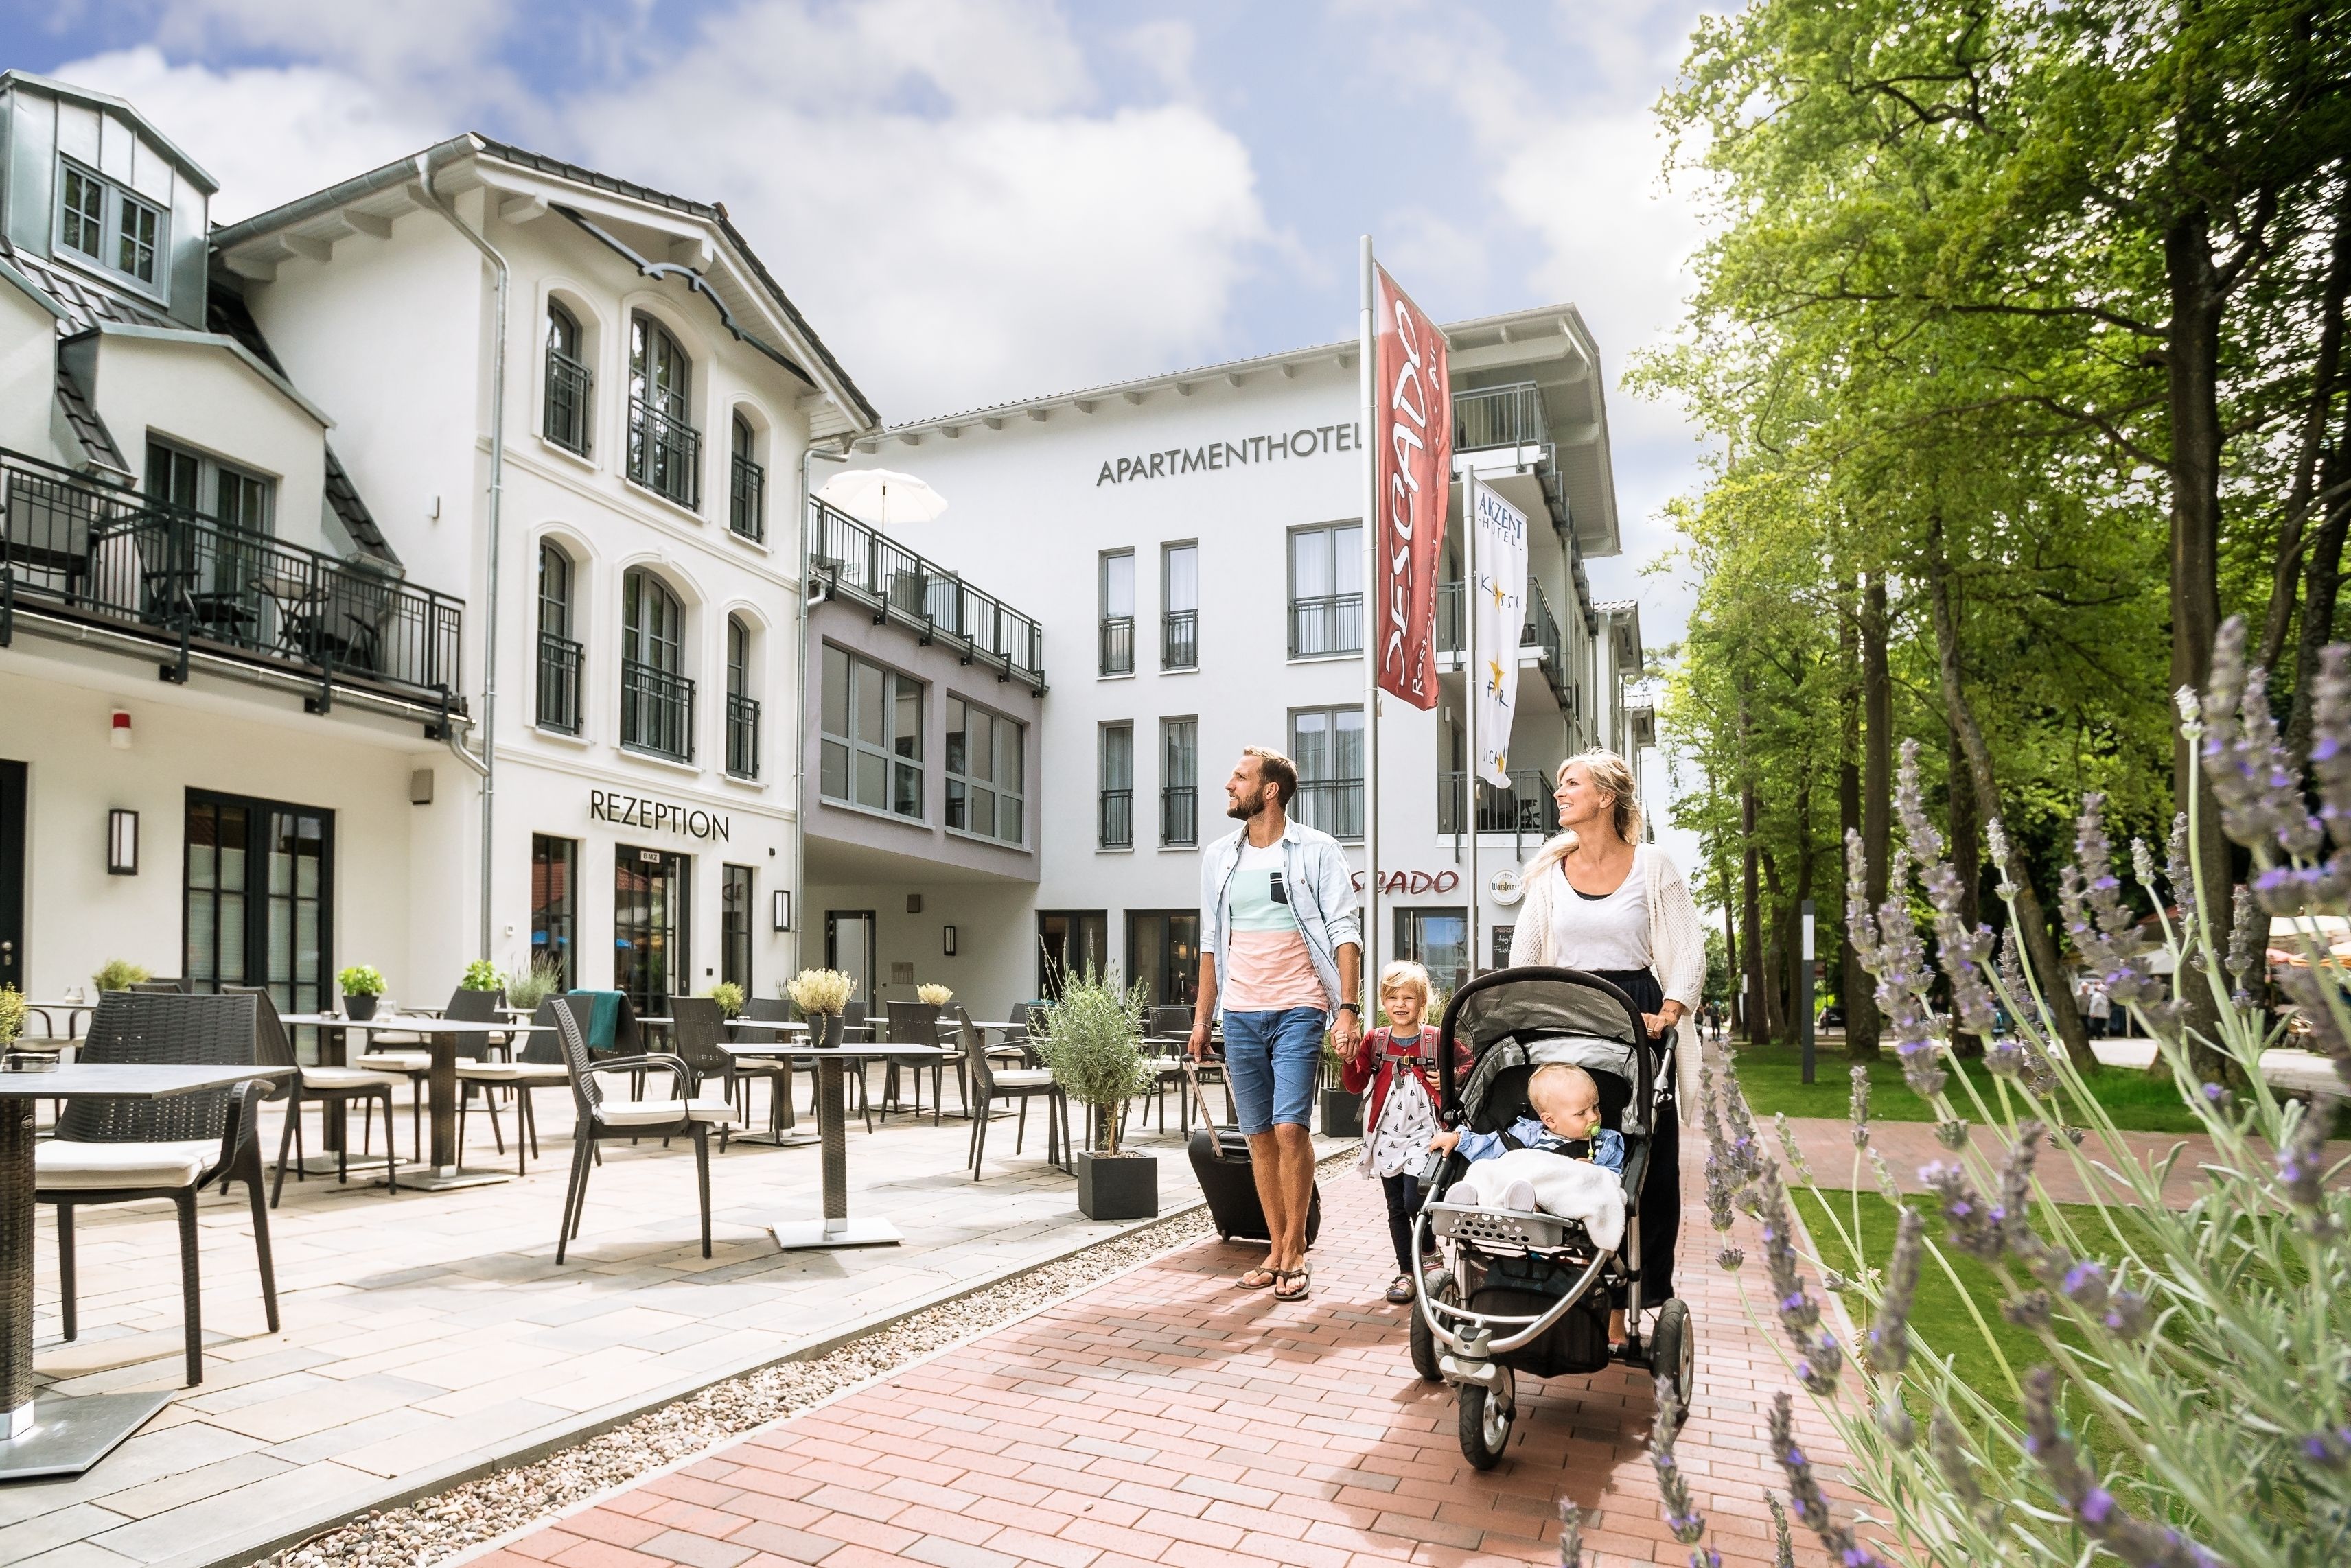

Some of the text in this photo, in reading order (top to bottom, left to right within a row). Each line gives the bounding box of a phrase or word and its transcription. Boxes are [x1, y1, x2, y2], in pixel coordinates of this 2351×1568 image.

[1096, 422, 1362, 487] APARTMENTHOTEL
[1385, 299, 1426, 687] DESCADO
[1479, 493, 1522, 539] AKZENT
[1483, 517, 1516, 546] HOTEL
[590, 789, 729, 843] REZEPTION
[643, 852, 658, 861] BMZ
